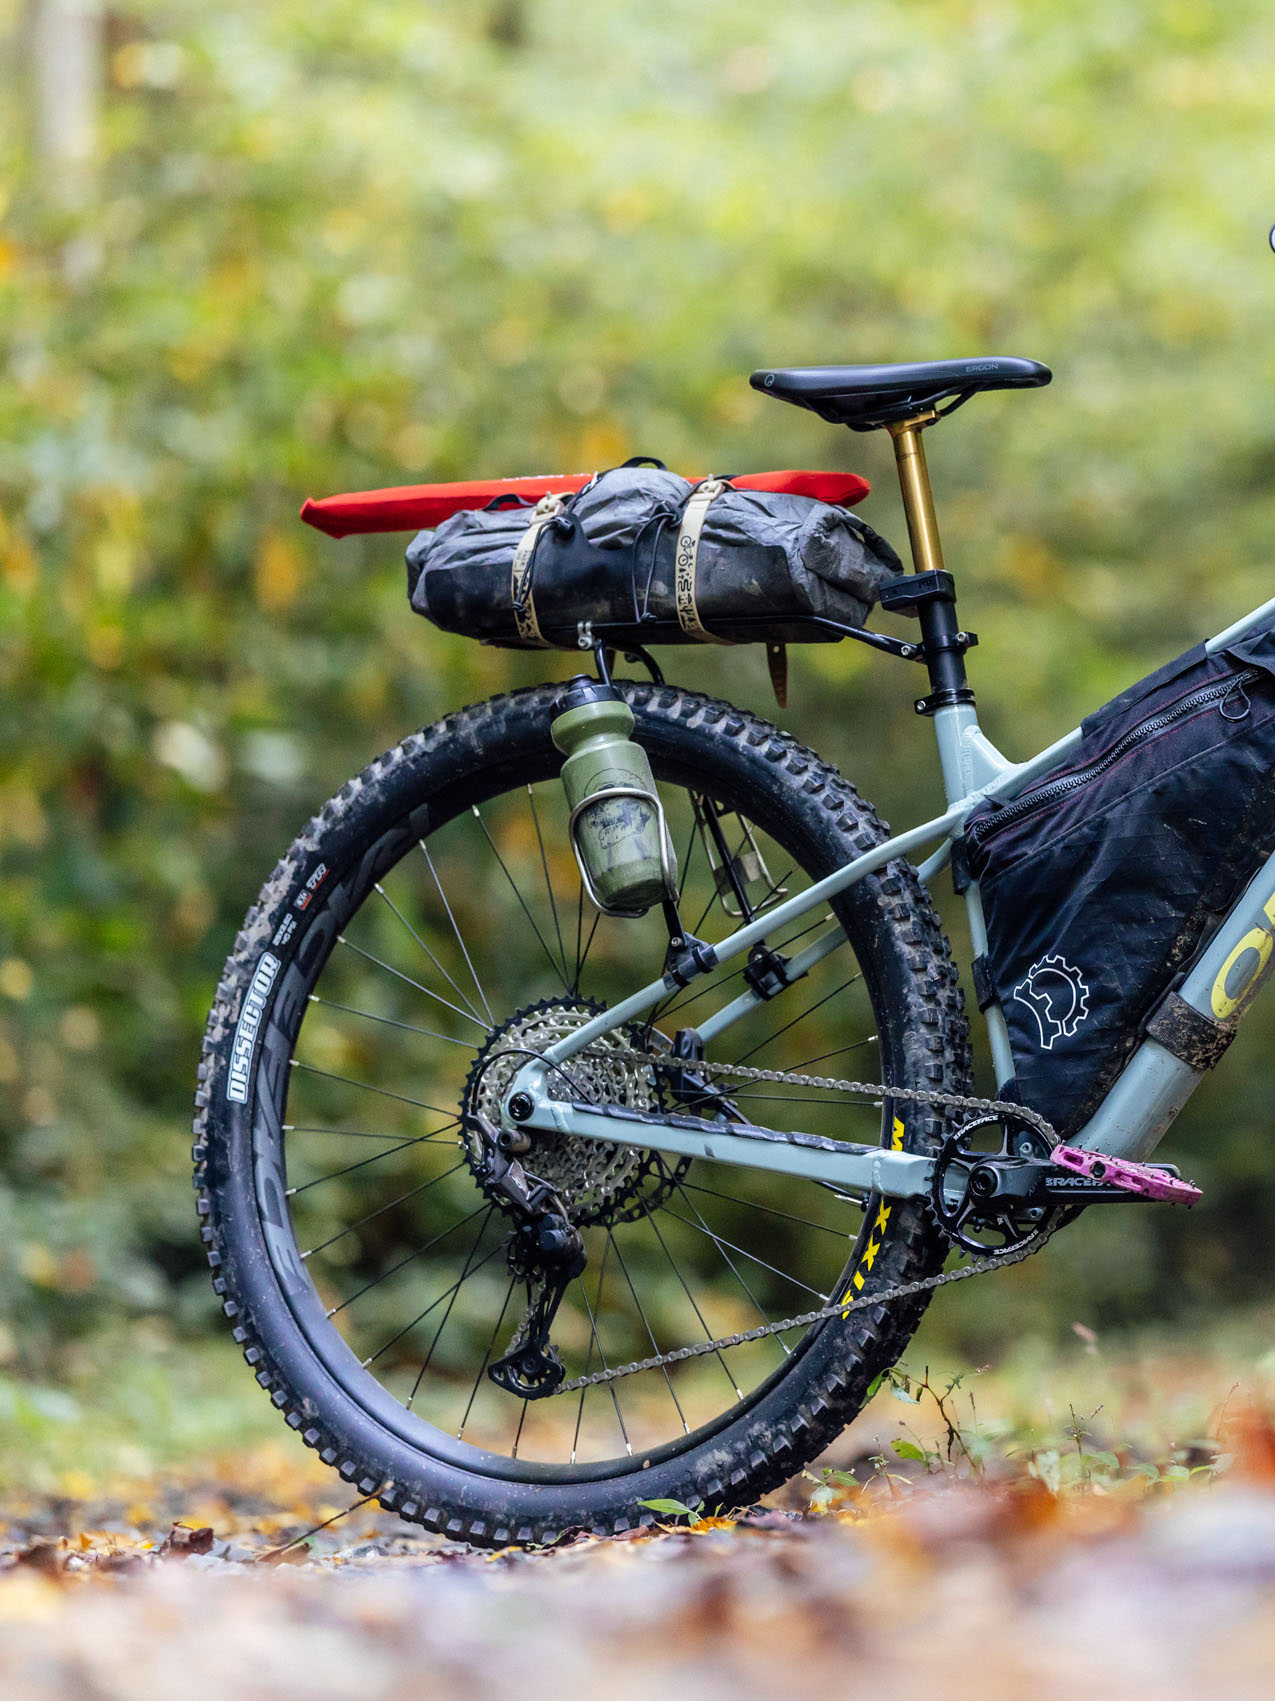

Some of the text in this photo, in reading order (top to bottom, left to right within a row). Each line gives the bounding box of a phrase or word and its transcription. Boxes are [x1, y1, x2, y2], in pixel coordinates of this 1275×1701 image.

[965, 363, 999, 373] ERGON
[227, 952, 281, 1103] DISSECTOR
[841, 1116, 905, 1320] MXXIS
